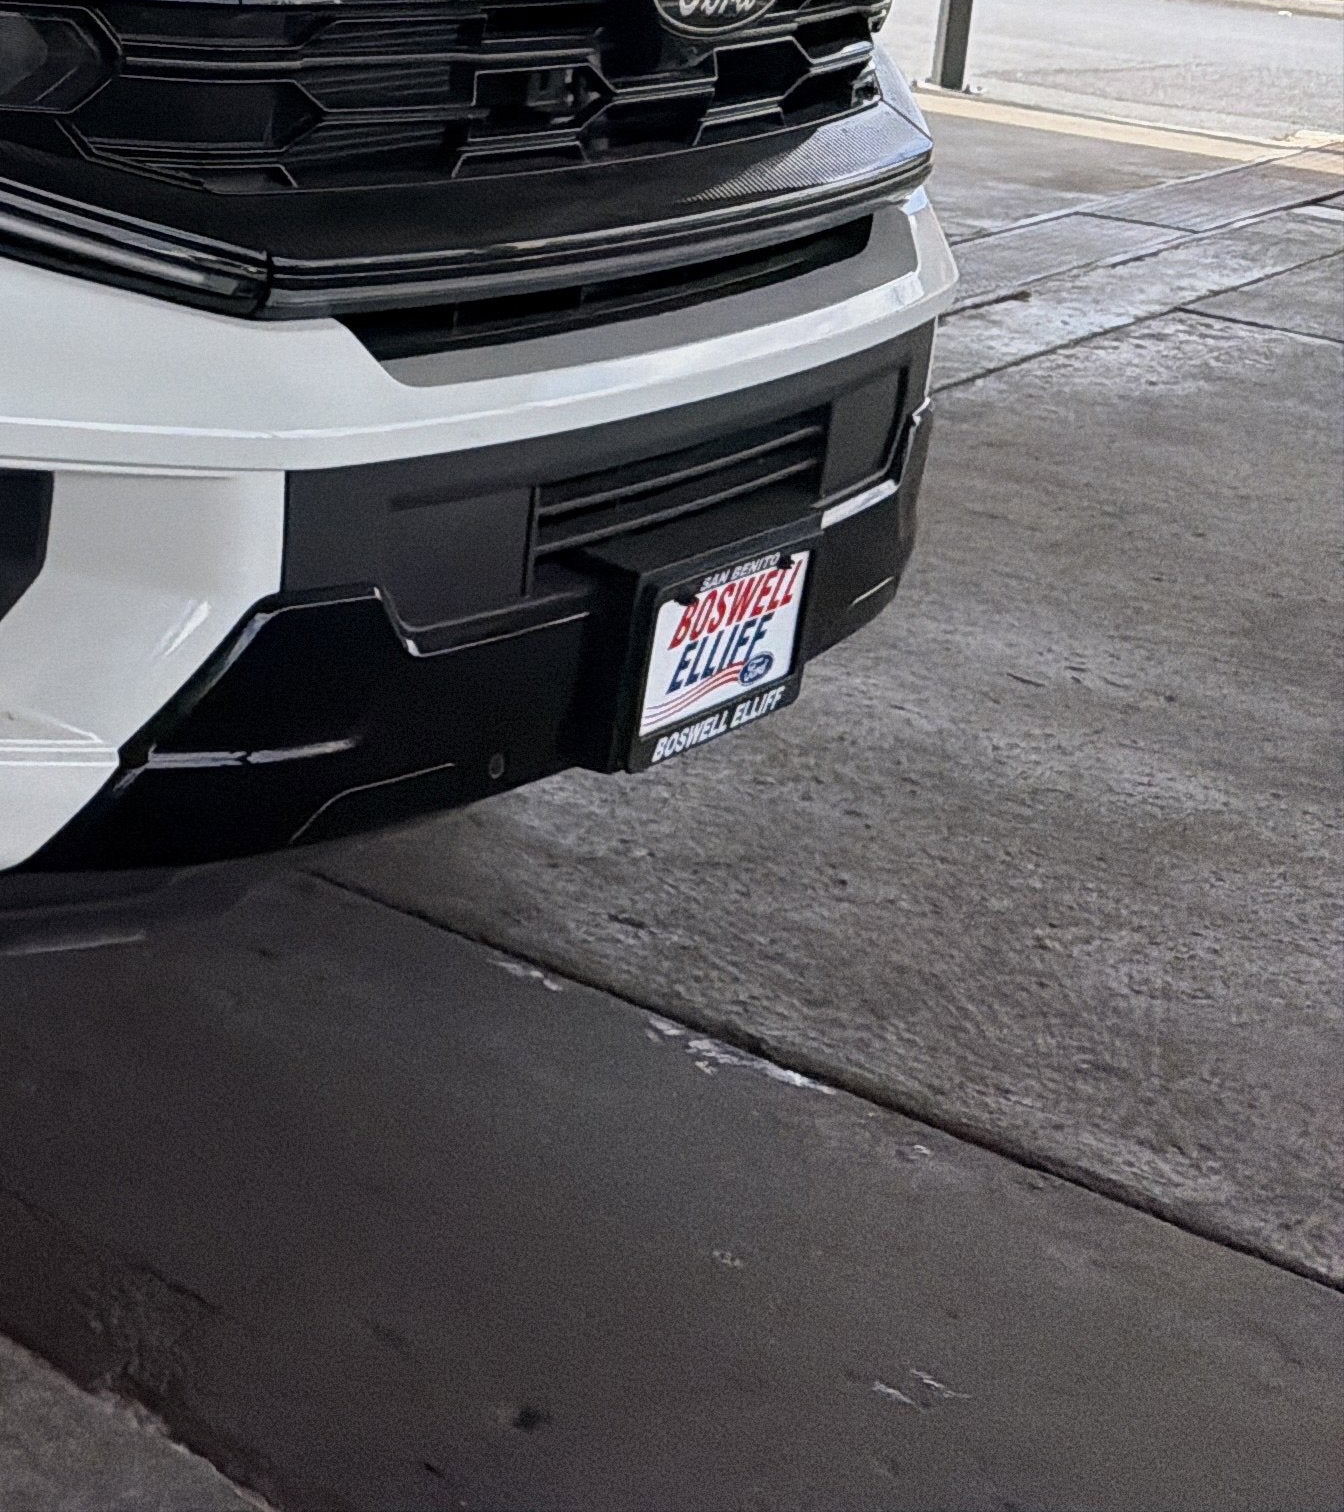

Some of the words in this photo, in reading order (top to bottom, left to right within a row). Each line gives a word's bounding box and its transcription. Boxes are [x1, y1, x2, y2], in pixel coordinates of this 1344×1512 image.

[667, 558, 805, 651] BOSWELL
[699, 568, 729, 592] SAN
[731, 551, 781, 579] BENITO
[665, 611, 776, 695] ELLIFF
[651, 715, 729, 763] BOSWELL
[730, 685, 786, 729] ELLIFF
